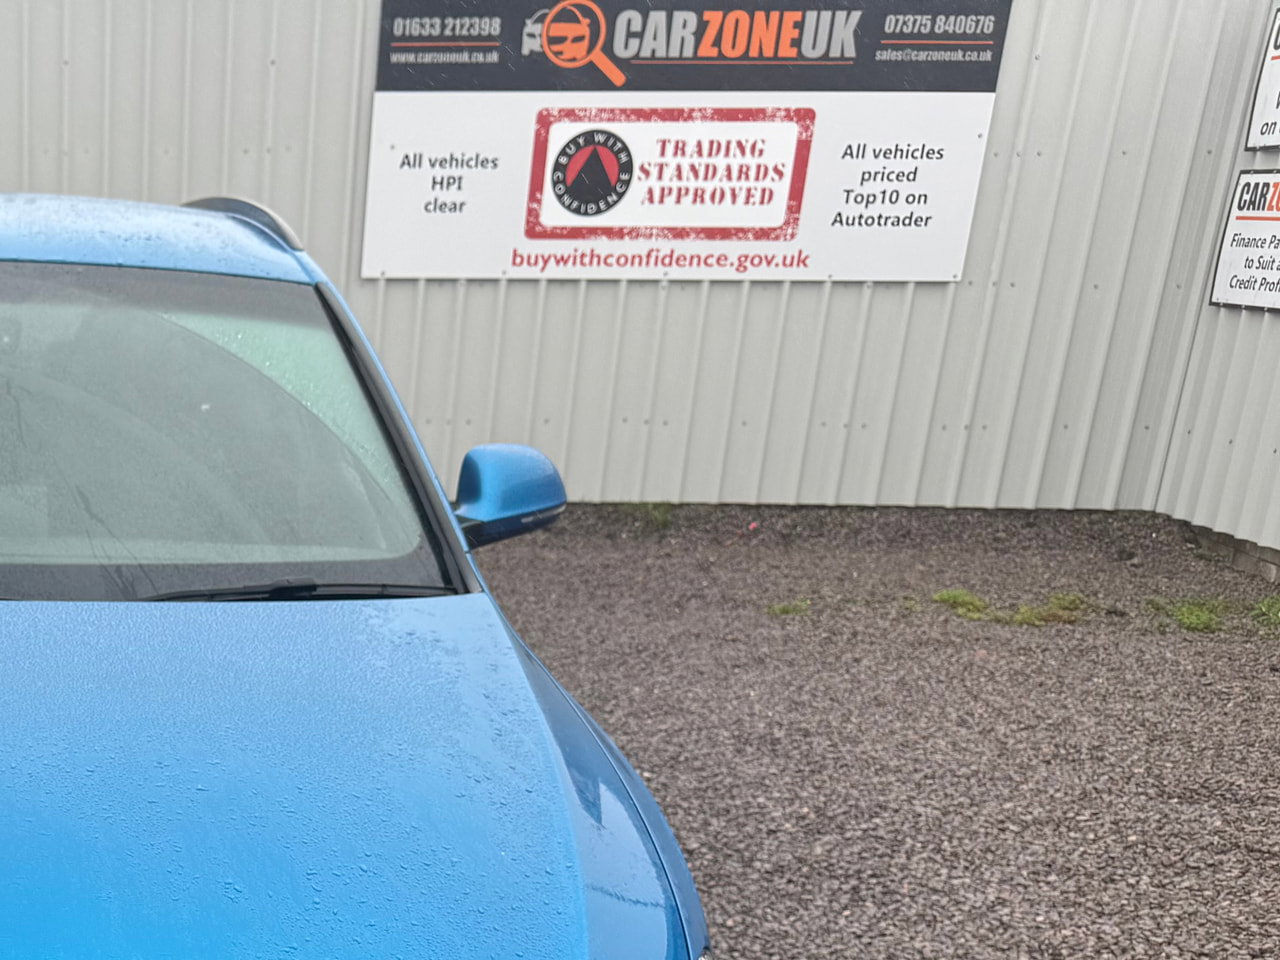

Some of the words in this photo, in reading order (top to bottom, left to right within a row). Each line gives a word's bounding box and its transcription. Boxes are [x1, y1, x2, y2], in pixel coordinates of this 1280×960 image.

[393, 17, 441, 36] 01633
[443, 17, 502, 36] 212398
[884, 14, 932, 34] 07375
[933, 15, 995, 34] 840676
[613, 9, 862, 59] CARZONEUK
[875, 48, 993, 62] sales@carzoneuk.co.uk
[557, 135, 586, 165] BUY
[593, 131, 630, 164] WITH
[656, 138, 766, 159] TRADING
[841, 143, 867, 160] All
[872, 143, 945, 160] vehicles
[399, 153, 423, 170] All
[427, 152, 499, 170] vehicles
[637, 162, 785, 183] STANDARDS
[860, 167, 918, 187] priced
[431, 176, 464, 191] HPI
[553, 170, 631, 215] CONFIDENCE
[424, 197, 467, 213] clear
[641, 186, 775, 206] APPROVED
[905, 193, 929, 206] on
[831, 211, 933, 228] Autotrader
[1230, 233, 1267, 249] Finance
[511, 248, 810, 273] buywithconfidence.gov.uk
[1244, 256, 1254, 270] to
[1255, 256, 1275, 271] Suit
[1229, 275, 1257, 292] Credit
